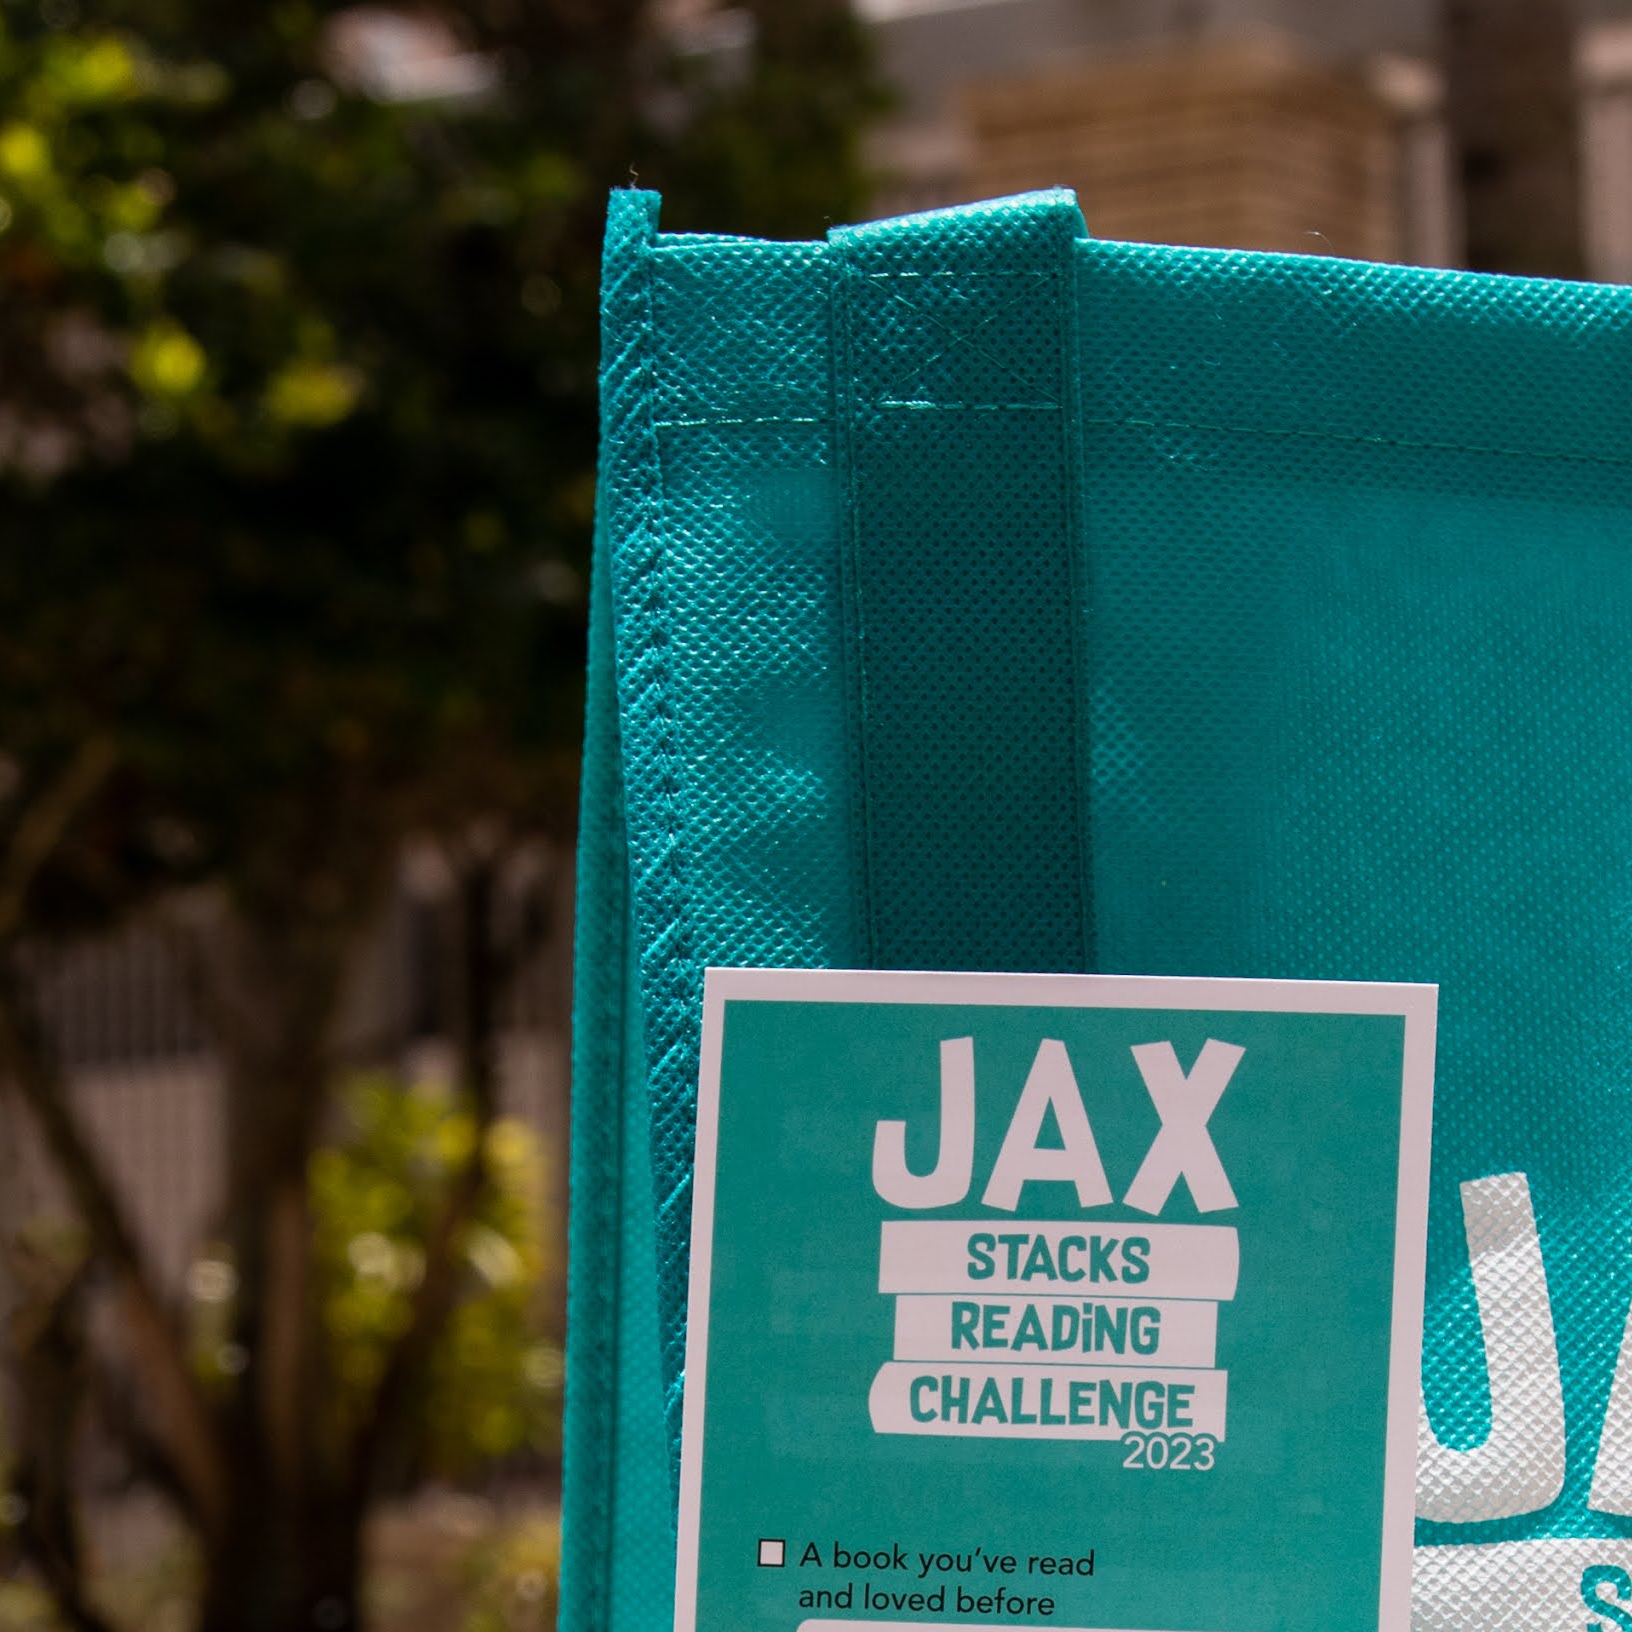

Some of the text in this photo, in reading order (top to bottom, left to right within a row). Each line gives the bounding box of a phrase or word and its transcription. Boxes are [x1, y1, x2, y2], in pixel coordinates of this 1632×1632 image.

[871, 1036, 1246, 1216] JAX
[966, 1231, 1151, 1285] STACKS
[909, 1375, 1195, 1430] CHALLENGE
[1122, 1437, 1216, 1472] 2023
[799, 1541, 1096, 1579] A book you've read
[798, 1582, 1056, 1616] and loved before
